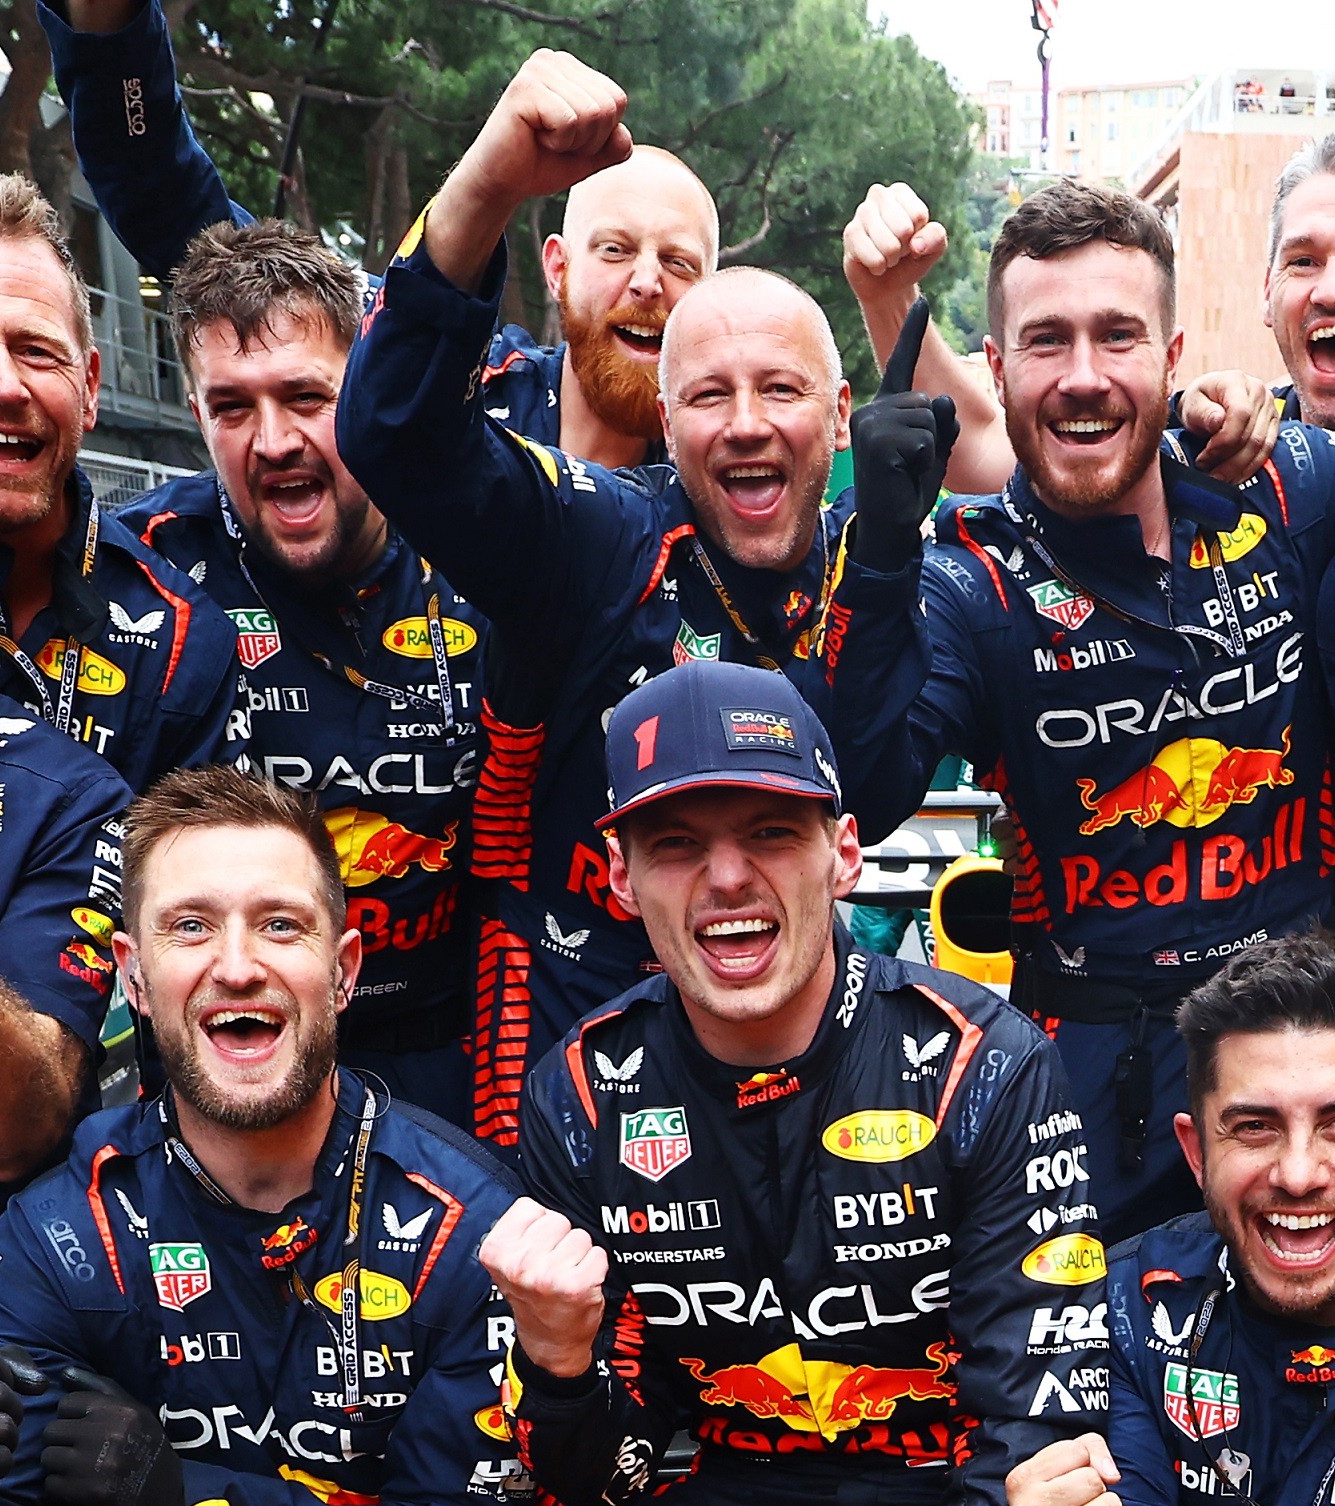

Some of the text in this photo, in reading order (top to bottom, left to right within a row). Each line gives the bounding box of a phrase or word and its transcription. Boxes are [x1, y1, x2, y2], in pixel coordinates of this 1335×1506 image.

[1203, 571, 1280, 628] BBIT
[1213, 567, 1244, 649] GRID ACCESS
[109, 633, 158, 649] CASTORE
[407, 625, 465, 647] RACH
[431, 622, 444, 671] ACCESS
[1034, 640, 1106, 672] Mobil
[61, 652, 76, 701] ACCESS
[1036, 632, 1304, 748] ORACLE
[250, 687, 280, 711] bil
[730, 712, 790, 727] ORACLE
[733, 723, 768, 735] Red Bull
[633, 715, 659, 771] 1
[735, 736, 795, 749] RACING
[254, 753, 476, 794] RACLE
[1060, 841, 1187, 914] Red
[1201, 797, 1305, 899] Bull
[540, 938, 582, 962] CASTORE
[1184, 930, 1268, 962] C. ADAMS
[351, 980, 408, 997] GREEN
[836, 953, 868, 1029] zoom
[738, 1076, 801, 1109] Red Bull
[628, 1112, 683, 1136] TAG
[854, 1122, 923, 1147] RAUCH
[624, 1137, 688, 1175] HEUER
[601, 1200, 684, 1234] Mobil
[834, 1182, 939, 1229] BYBIT
[262, 1246, 288, 1270] Red
[623, 1246, 726, 1264] POKERSTARS
[834, 1233, 952, 1262] HONDA
[1053, 1247, 1105, 1270] RAUCH
[628, 1270, 950, 1341] ORACLE
[1196, 1301, 1213, 1337] 2023
[345, 1291, 359, 1388] GRID ACCESS
[1027, 1339, 1109, 1355] Honda RACIN
[316, 1346, 414, 1378] BBIT
[1286, 1367, 1317, 1383] Red
[1170, 1370, 1239, 1402] TAG
